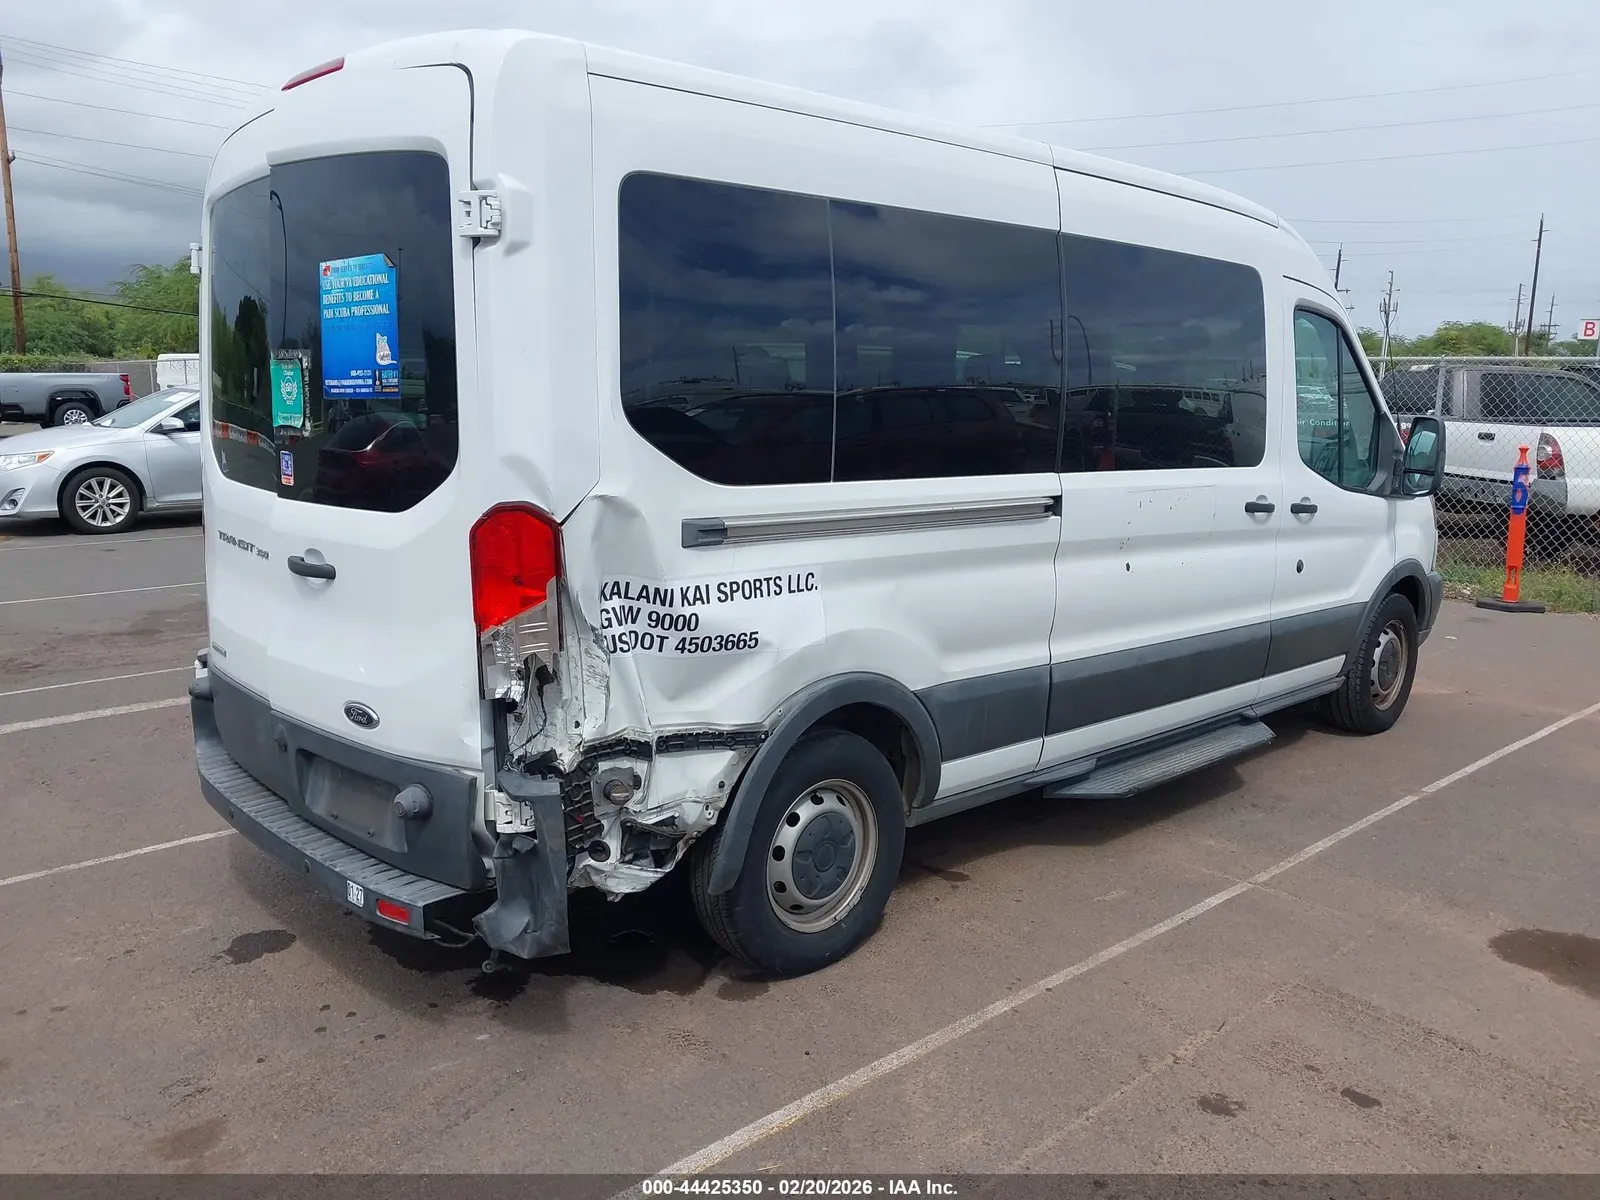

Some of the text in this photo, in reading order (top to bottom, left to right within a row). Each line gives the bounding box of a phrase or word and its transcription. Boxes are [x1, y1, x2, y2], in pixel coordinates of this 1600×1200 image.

[323, 280, 332, 290] USE
[332, 278, 344, 289] YOUR
[352, 273, 389, 287] EDUCATIONAL
[323, 289, 379, 304] BENEFITS TO BECOME A
[323, 303, 390, 318] PADI SCUBA PROFESSIONAL
[1584, 322, 1596, 337] B
[217, 530, 255, 553] TRANSIT
[600, 572, 818, 608] KALANI KAI SPORTS LLC.
[600, 605, 699, 632] GVW 9000
[604, 630, 759, 654] USDOT 4503665
